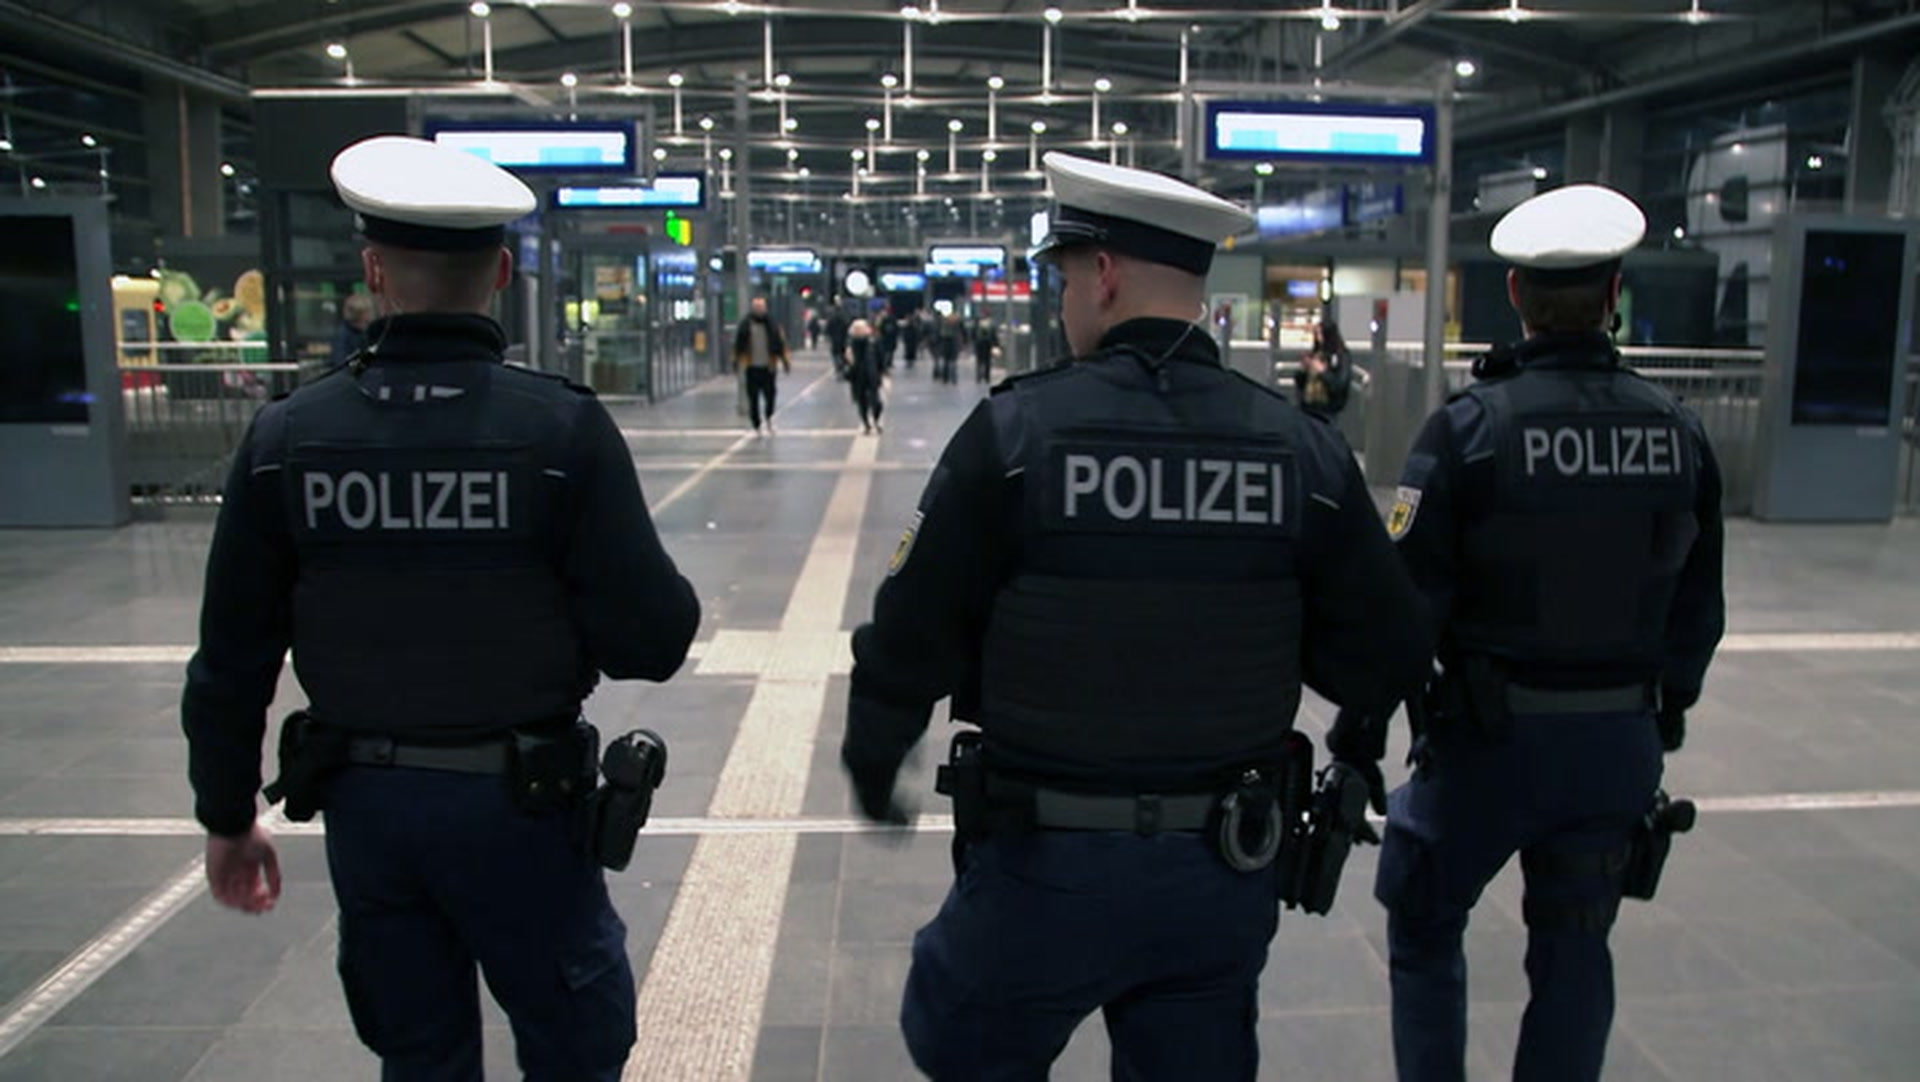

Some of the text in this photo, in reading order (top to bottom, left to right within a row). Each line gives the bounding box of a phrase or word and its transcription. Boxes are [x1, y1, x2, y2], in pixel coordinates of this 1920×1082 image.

[1524, 426, 1682, 476] POLIZEI
[303, 471, 510, 530] POLIZEI
[1064, 454, 1284, 525] POLIZEI
